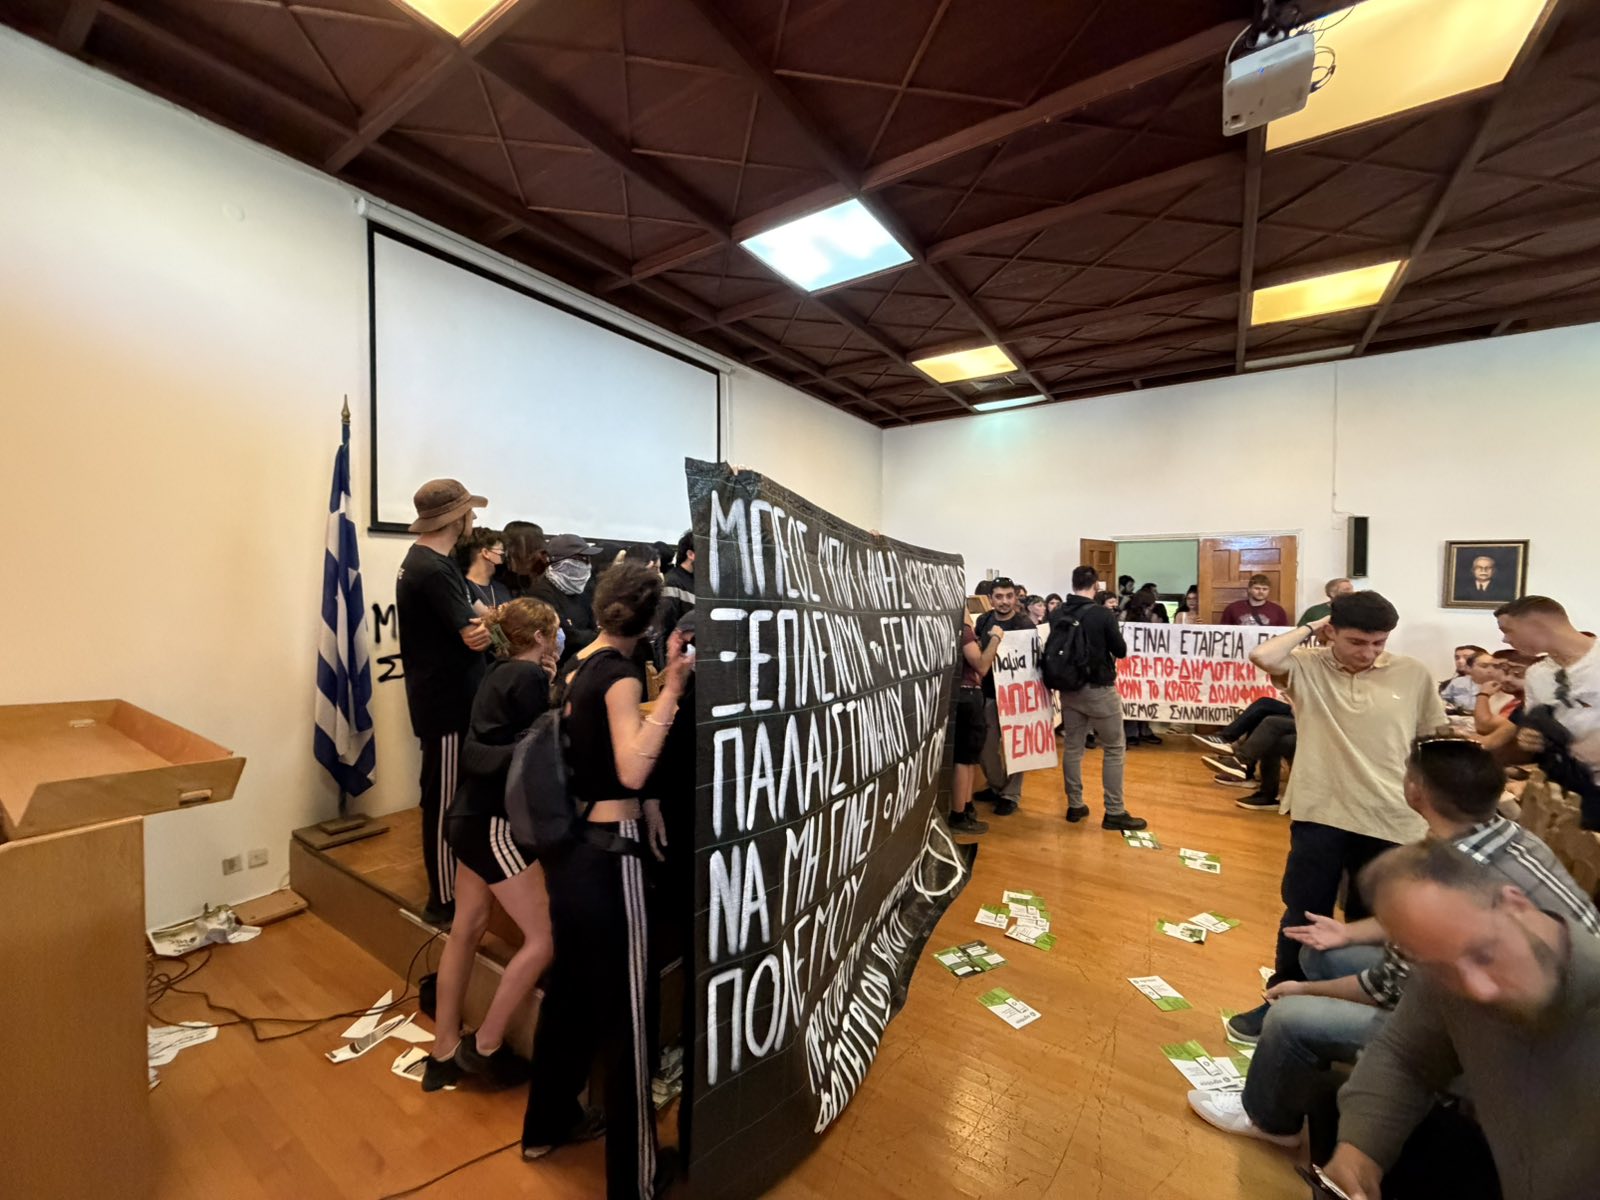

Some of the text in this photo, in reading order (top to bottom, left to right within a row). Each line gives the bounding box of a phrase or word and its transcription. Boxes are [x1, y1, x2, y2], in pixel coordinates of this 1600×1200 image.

[1133, 626, 1170, 654] ΕΙΝΑΙ
[1180, 629, 1244, 659] ΕΤΑΙΡΕΙΑ
[1164, 681, 1202, 703] ΚΡΑΤΟΣ
[708, 839, 770, 962] ΝΑ
[781, 812, 823, 926] ΜΗ
[707, 863, 867, 1086] ΠΟΛΕΜΟΥ
